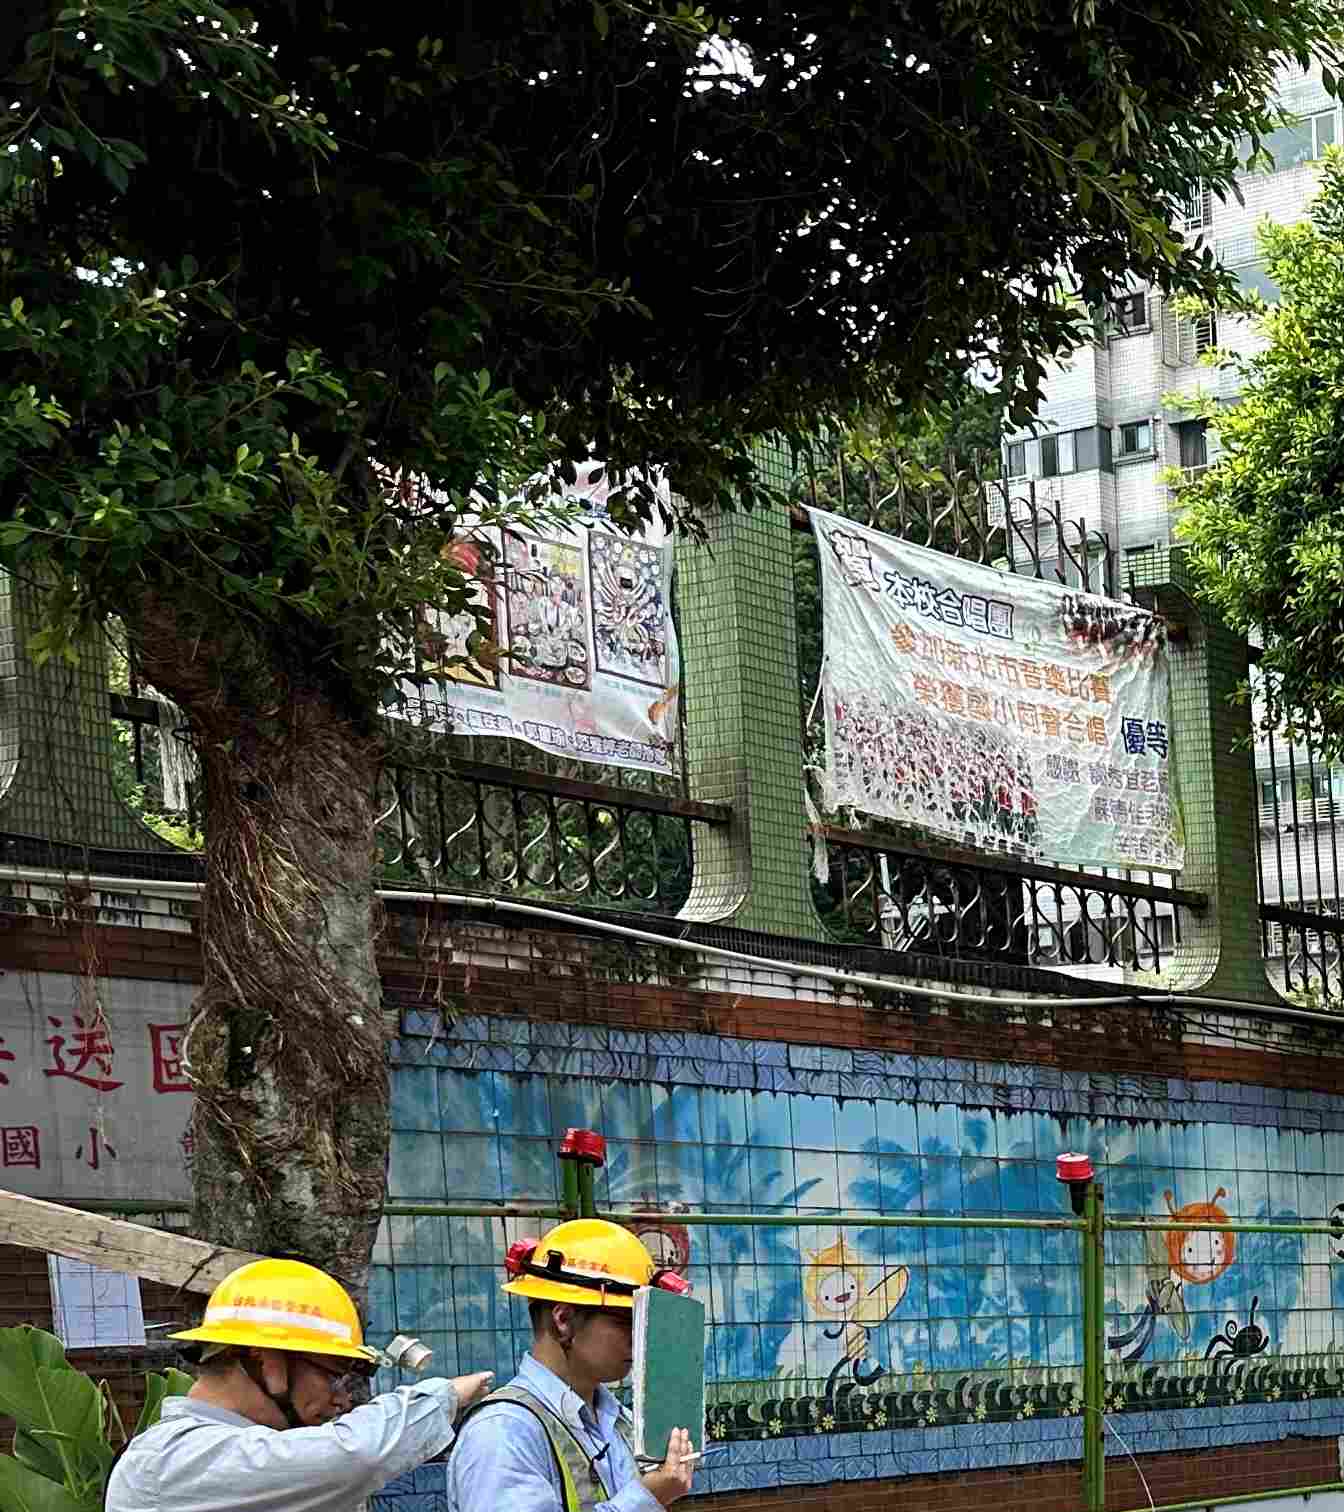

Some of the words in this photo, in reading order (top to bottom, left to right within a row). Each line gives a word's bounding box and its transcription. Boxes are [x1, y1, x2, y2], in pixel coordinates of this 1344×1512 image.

[884, 570, 1015, 640] 本校合唱團
[1120, 715, 1170, 760] 優等
